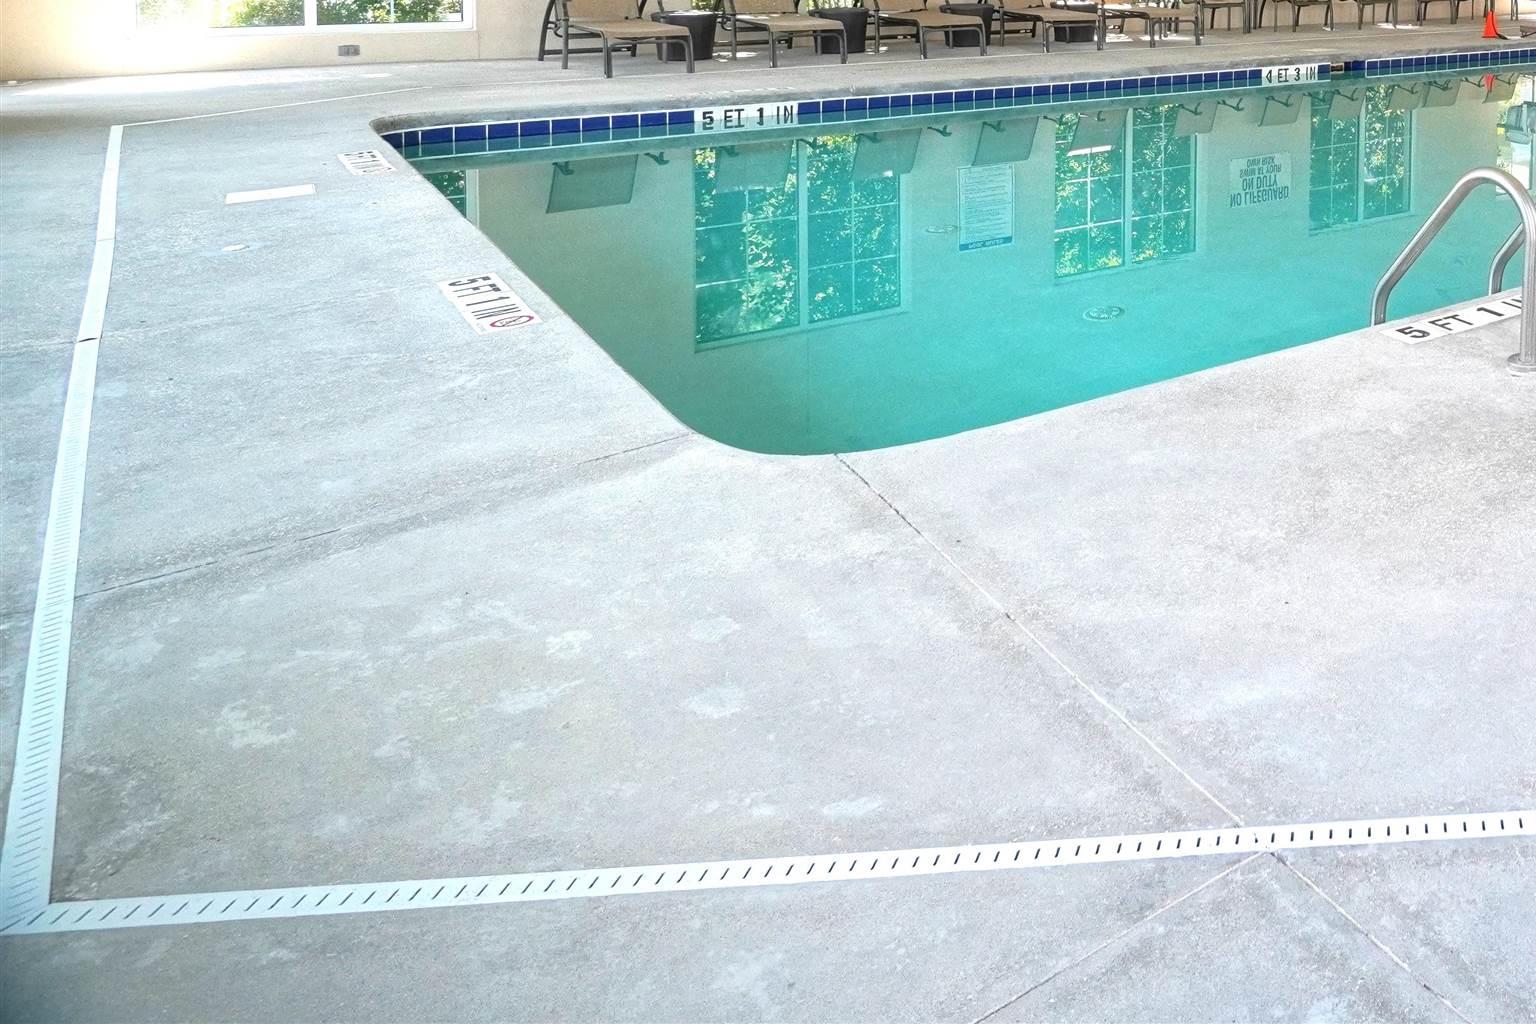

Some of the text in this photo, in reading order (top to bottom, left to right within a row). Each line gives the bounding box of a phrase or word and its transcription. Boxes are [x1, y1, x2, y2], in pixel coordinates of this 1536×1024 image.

[448, 275, 522, 321] 5 FT 1 IN
[1395, 326, 1431, 339] 5
[1427, 314, 1474, 332] FT
[1476, 306, 1505, 317] 1
